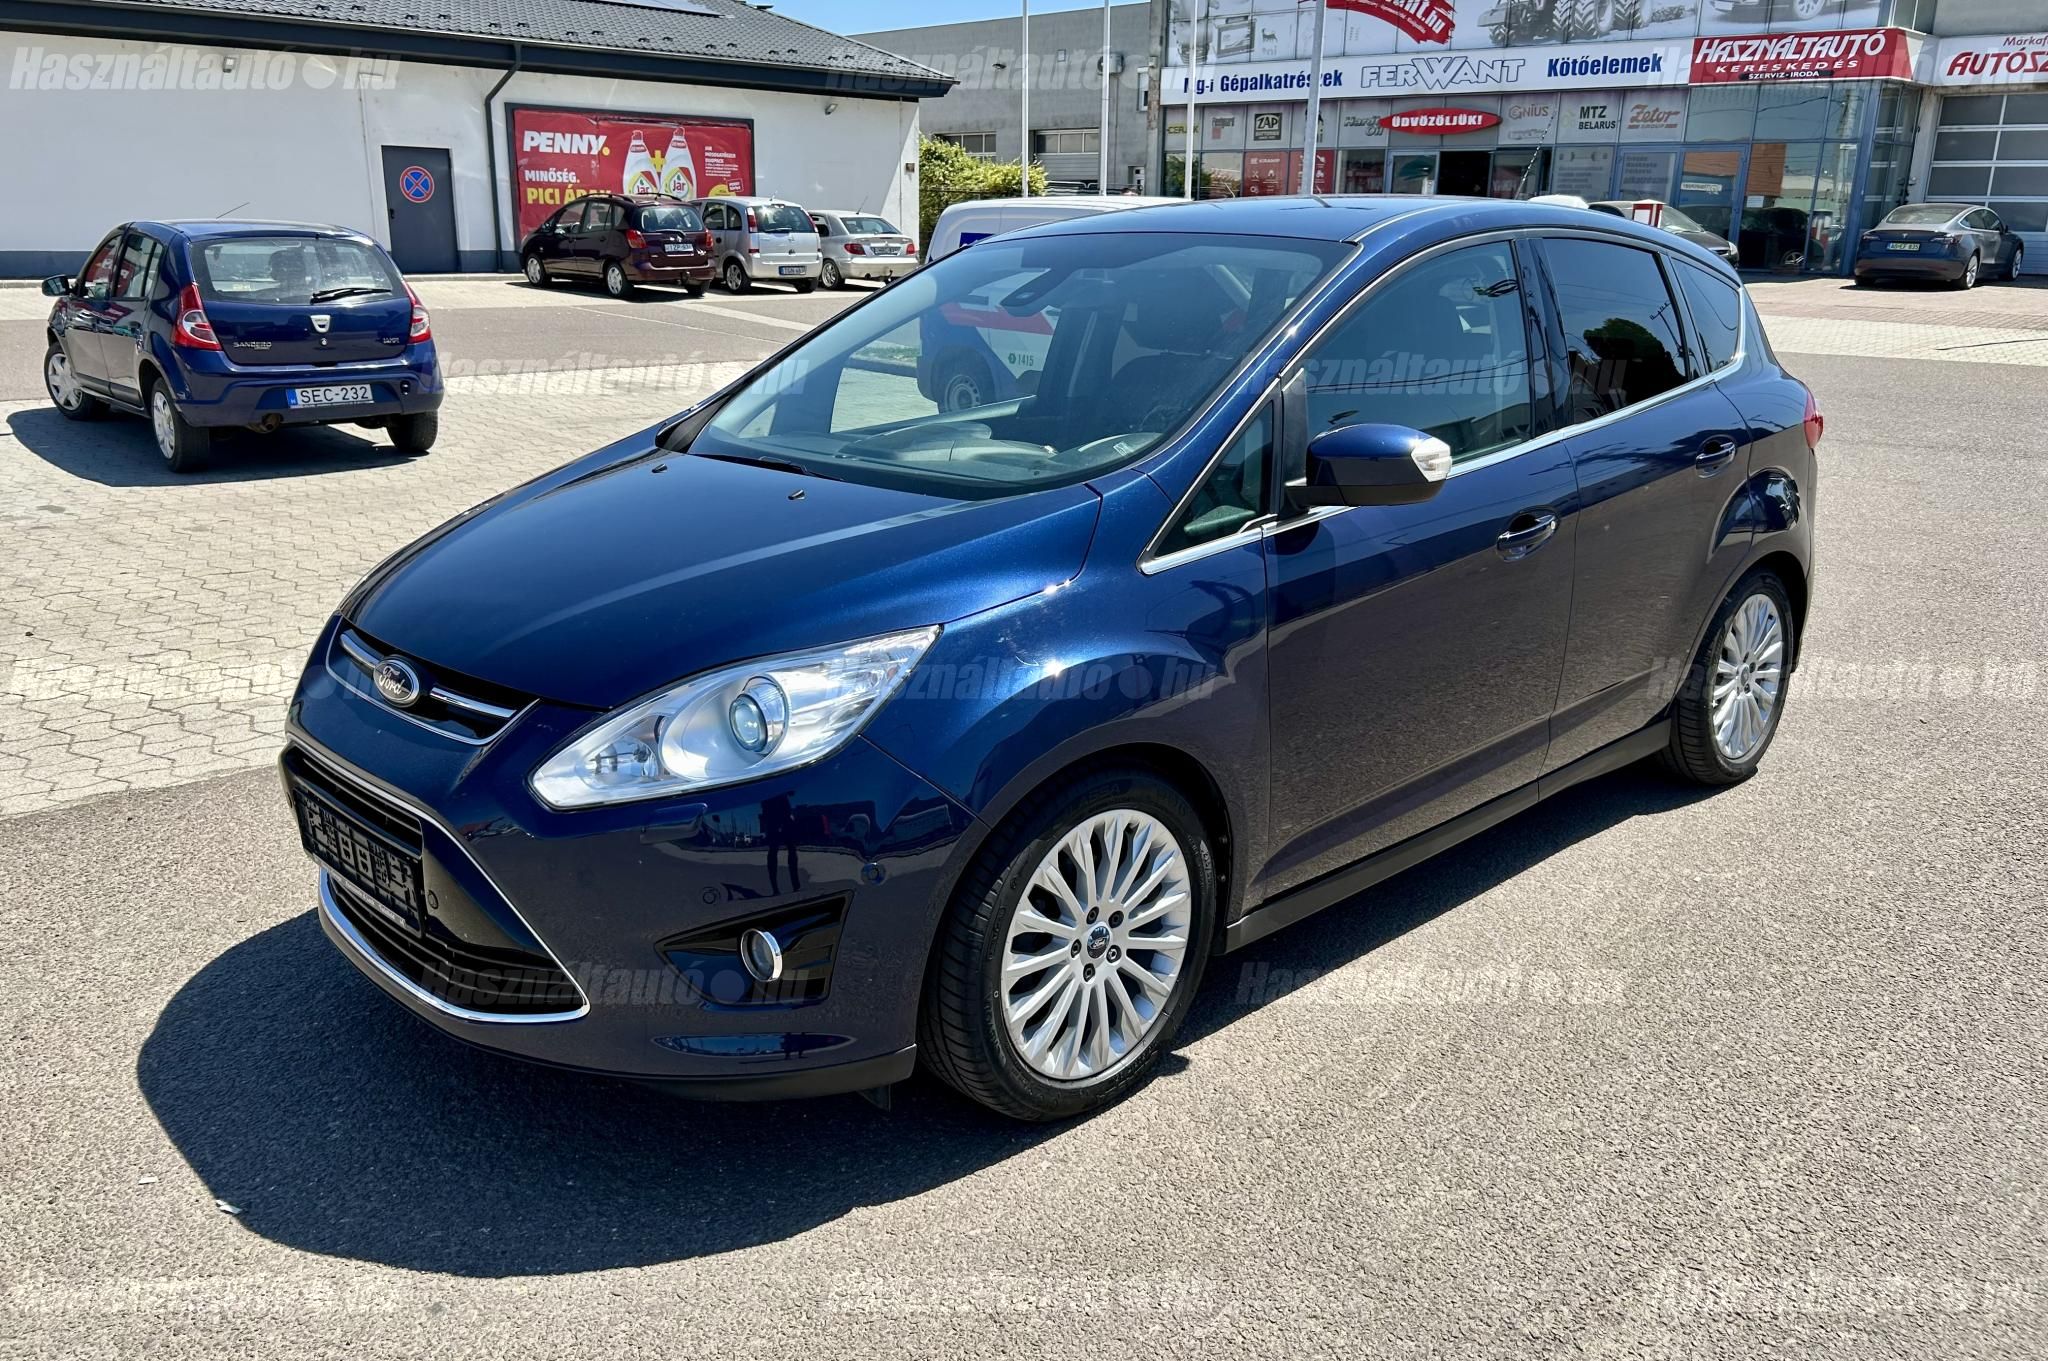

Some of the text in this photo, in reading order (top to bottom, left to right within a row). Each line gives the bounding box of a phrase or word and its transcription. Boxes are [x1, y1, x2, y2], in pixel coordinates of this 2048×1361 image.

[1695, 30, 1886, 64] HASZNÁLTAUTÓ
[1361, 56, 1526, 90] FERWANT
[1547, 53, 1662, 79] Kötőelemek
[1715, 60, 1859, 74] KERESKEDÉS
[1220, 69, 1343, 93] Gépalkatréek
[1391, 113, 1484, 128] ÜDVÖZÖLJÜK!
[1580, 105, 1608, 119] MTZ
[1630, 104, 1680, 123] Zetor
[1257, 116, 1279, 129] ZAP
[1578, 120, 1616, 130] BELARUS
[524, 167, 580, 184] MINŐSÉG.
[527, 187, 560, 205] PICI
[300, 386, 369, 404] SEC-232
[379, 666, 405, 696] Ford
